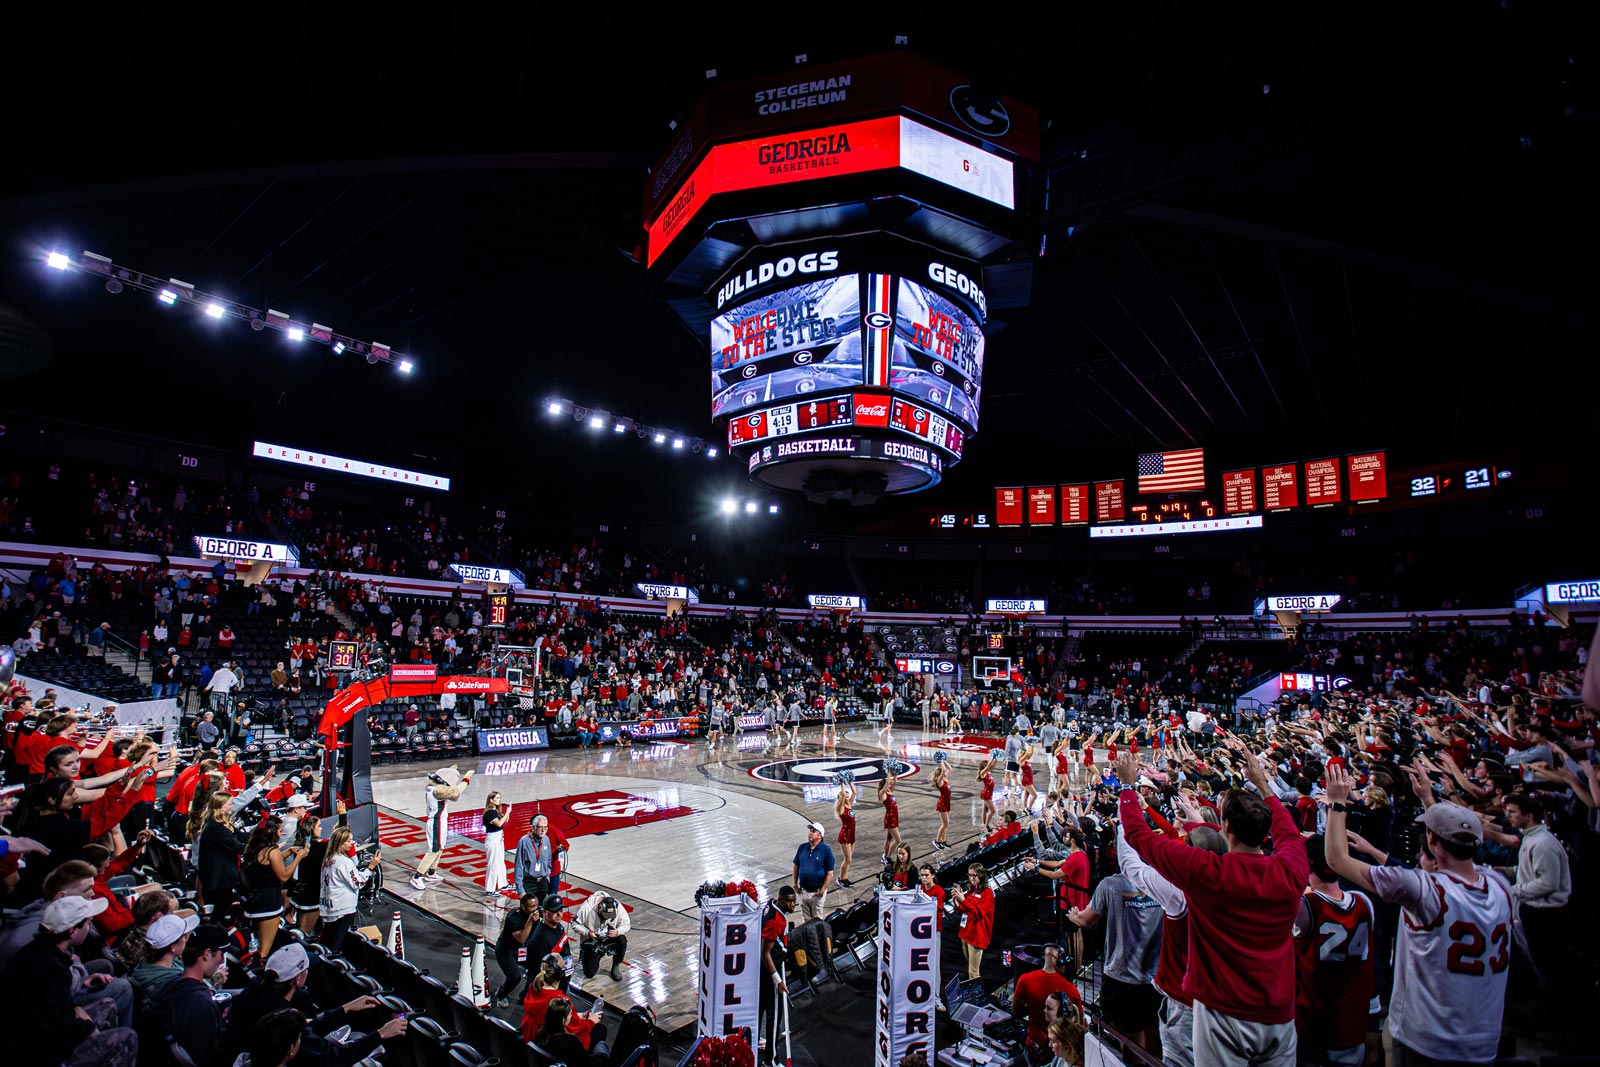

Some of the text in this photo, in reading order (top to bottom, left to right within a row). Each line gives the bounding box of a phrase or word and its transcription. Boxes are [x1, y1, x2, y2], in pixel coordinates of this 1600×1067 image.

[754, 74, 852, 103] STEGEMAN
[758, 89, 847, 115] COLISEUM
[758, 132, 851, 165] GEORGIA
[769, 156, 840, 174] BASKETBALL
[663, 180, 695, 233] GEORGIA
[717, 250, 839, 310] BULLDOGS
[732, 299, 819, 341] WELCOME
[721, 343, 739, 368] TO
[742, 330, 778, 360] THE
[912, 322, 932, 349] TO
[936, 332, 960, 366] THE
[772, 414, 792, 428] 4:19
[811, 417, 817, 427] 0
[778, 439, 855, 456] BASKETBALL
[884, 441, 929, 464] GEORGIA
[182, 456, 199, 468] DD
[1351, 461, 1381, 470] CHAMPIONS
[1465, 467, 1489, 483] 21
[303, 481, 315, 492] EE
[1411, 477, 1435, 490] 32
[1161, 503, 1180, 512] 4:19
[1207, 508, 1213, 517] 0
[940, 514, 955, 524] 45
[978, 514, 986, 524] 5
[1141, 513, 1147, 521] 0
[1155, 514, 1161, 522] 4
[492, 606, 505, 623] 30
[990, 639, 1001, 647] 30
[335, 654, 350, 666] 30
[487, 730, 541, 748] GEORGIA
[1318, 921, 1369, 962] 24
[1446, 920, 1509, 976] 23
